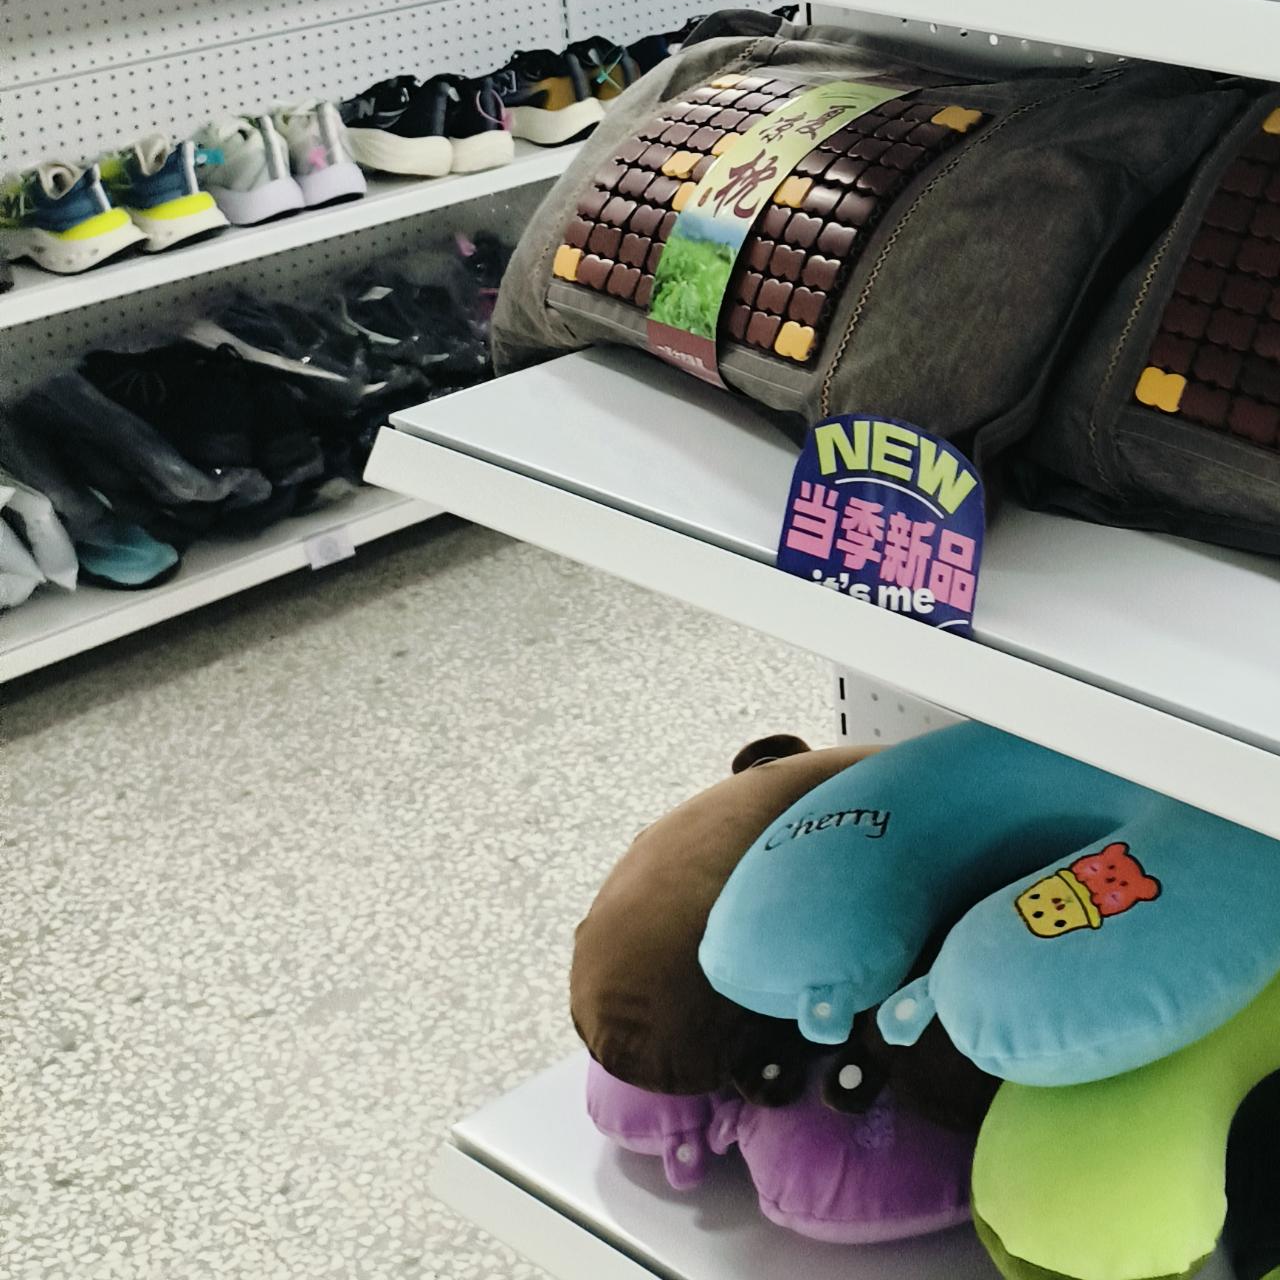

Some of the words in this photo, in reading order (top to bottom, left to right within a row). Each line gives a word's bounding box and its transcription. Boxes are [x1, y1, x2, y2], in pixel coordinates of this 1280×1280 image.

[815, 421, 978, 514] NEW
[786, 480, 977, 613] 当季新品
[878, 584, 936, 614] me
[764, 809, 891, 852] Cherry
